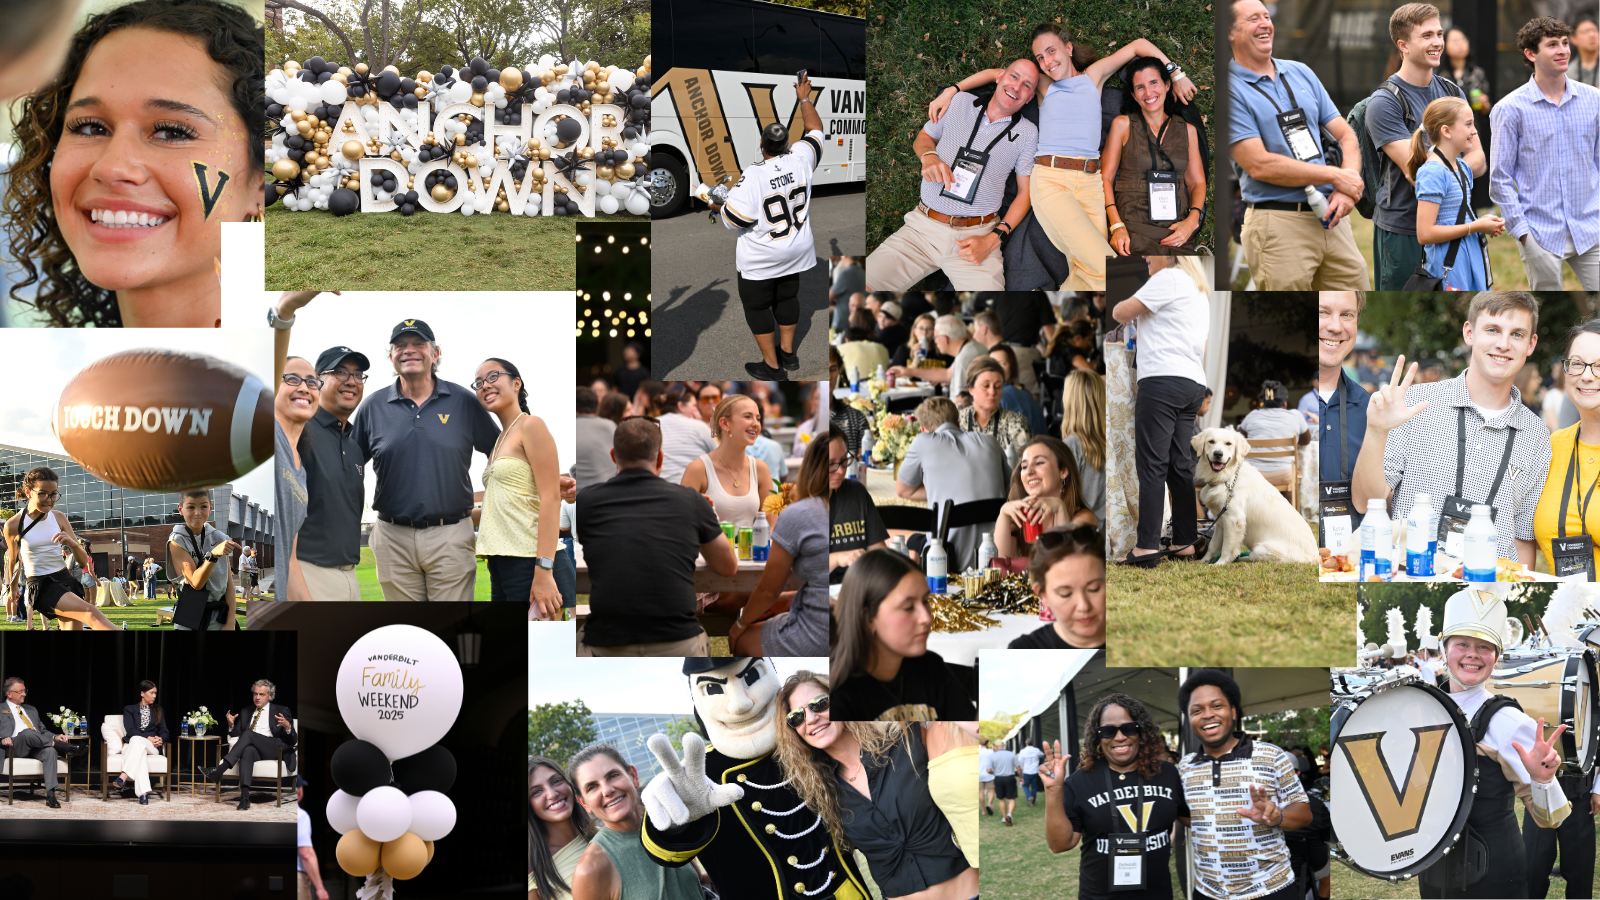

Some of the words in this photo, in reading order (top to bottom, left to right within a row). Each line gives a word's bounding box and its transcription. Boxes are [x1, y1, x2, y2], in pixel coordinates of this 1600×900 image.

[830, 90, 865, 114] VAN
[328, 101, 630, 157] ANCHOR
[684, 77, 714, 142] ANCHOR
[704, 142, 728, 186] DOWN
[830, 119, 866, 135] COMMO
[1007, 129, 1020, 142] V
[359, 157, 597, 218] DOWN
[769, 172, 795, 190] STONE
[190, 160, 230, 222] V
[762, 183, 808, 242] 92
[438, 413, 450, 424] V
[1507, 463, 1522, 480] V
[1325, 486, 1333, 495] V
[1455, 502, 1465, 512] V
[1559, 542, 1567, 551] V
[368, 654, 419, 666] VANDERBILT
[361, 666, 426, 701] Family
[357, 691, 419, 710] WEEKEND
[377, 709, 405, 721] 2025
[1336, 723, 1453, 842] V
[1116, 801, 1156, 833] V
[1390, 848, 1415, 862] EVANS
[1220, 860, 1256, 868] VANDERBILT
